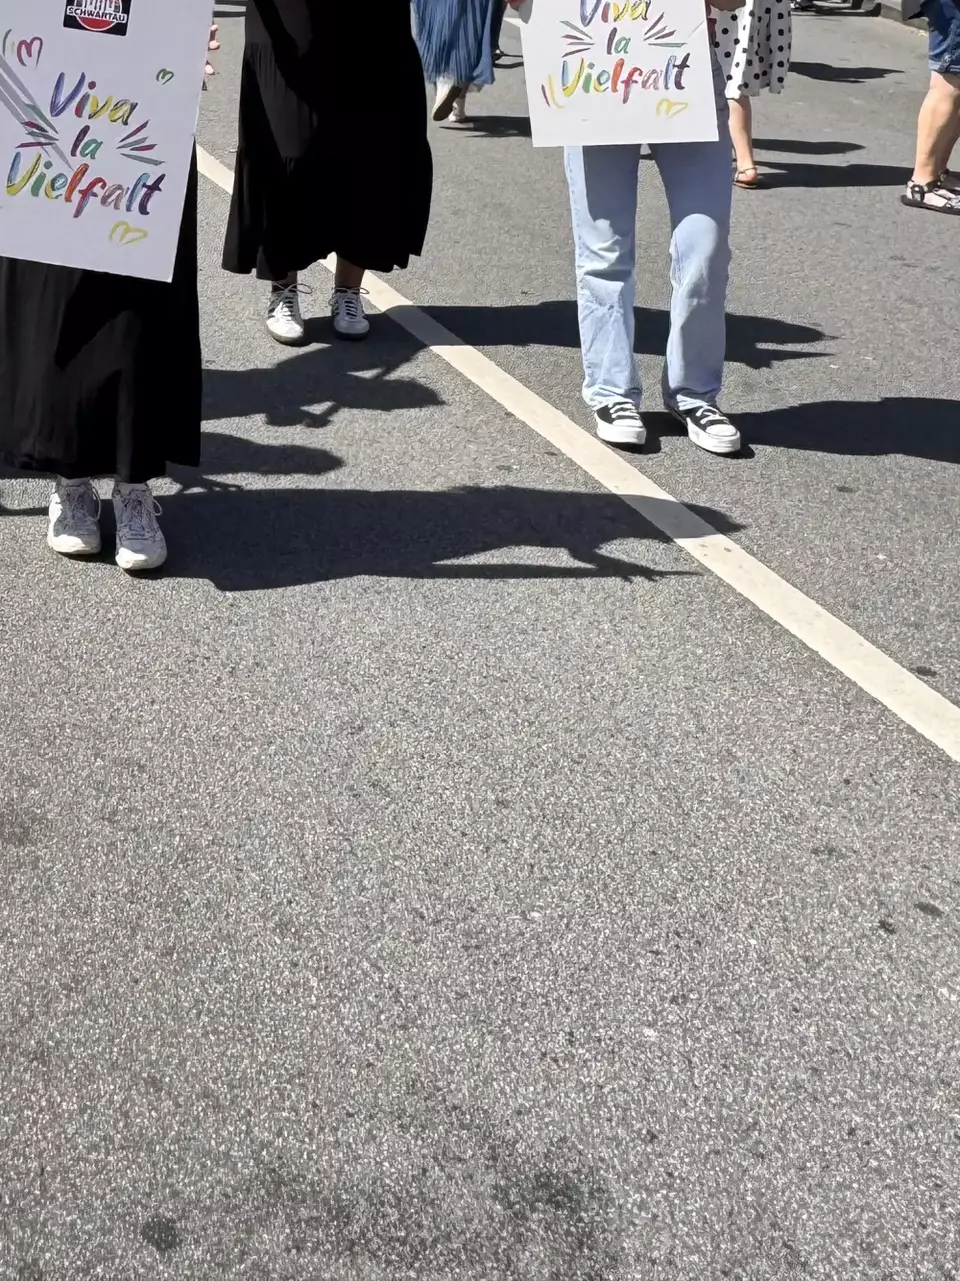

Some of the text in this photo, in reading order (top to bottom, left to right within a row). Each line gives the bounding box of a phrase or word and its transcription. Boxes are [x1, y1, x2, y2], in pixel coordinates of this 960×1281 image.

[68, 6, 126, 22] SCHWARTAU
[606, 27, 632, 55] la
[49, 71, 139, 126] Viva
[561, 52, 691, 105] Vielfalt
[70, 125, 104, 160] la
[5, 151, 167, 219] Vielfalt
